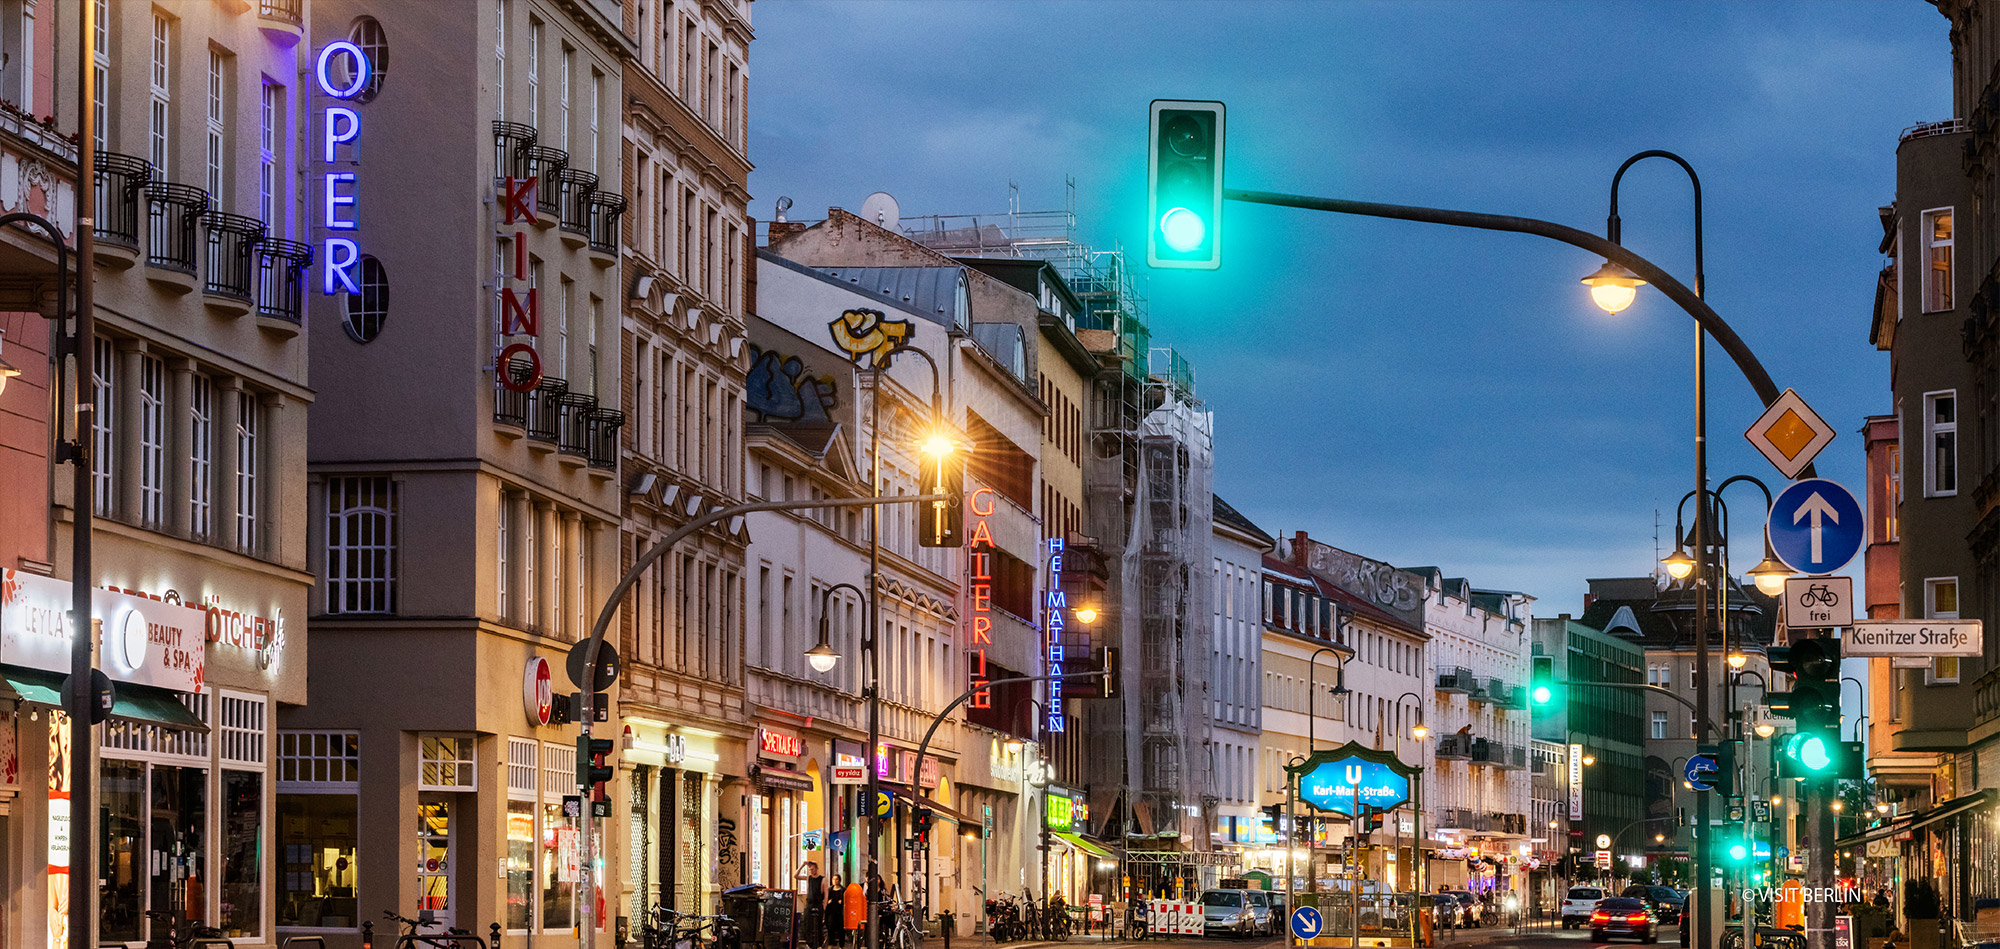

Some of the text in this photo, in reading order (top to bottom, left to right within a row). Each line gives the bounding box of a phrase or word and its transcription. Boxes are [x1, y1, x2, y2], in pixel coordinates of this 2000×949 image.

[316, 40, 370, 296] OPER
[497, 175, 543, 393] KINO
[970, 487, 995, 709] GALERIE
[25, 605, 64, 638] LEYLA
[1809, 610, 1831, 621] frei
[148, 622, 183, 647] BEAUTY
[1048, 537, 1066, 733] HEIMATHAFEN
[1852, 628, 1968, 648] Kienitzer Straße
[163, 648, 191, 670] & SPA
[792, 738, 799, 756] 44
[1346, 765, 1362, 785] U
